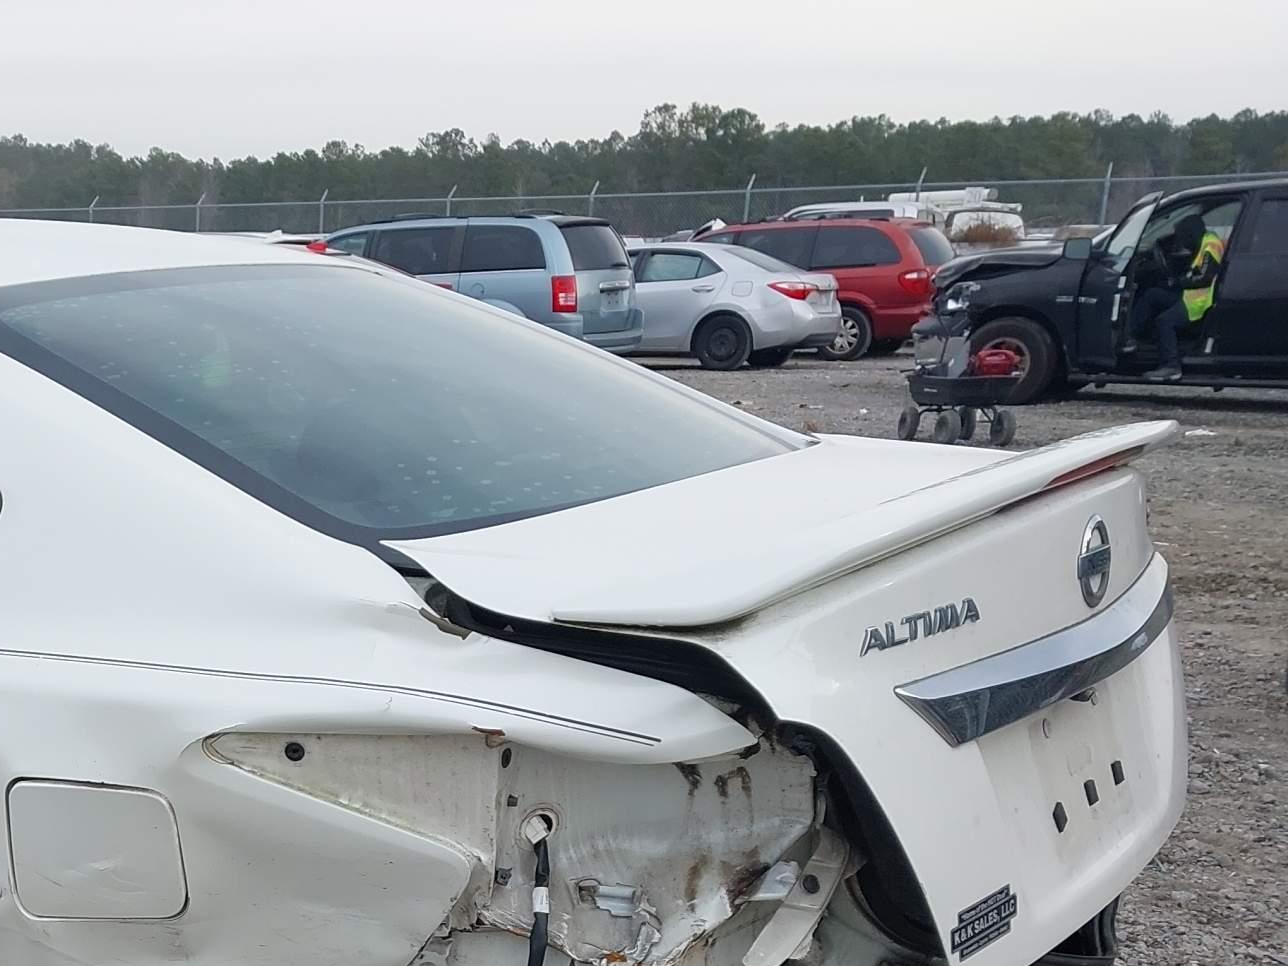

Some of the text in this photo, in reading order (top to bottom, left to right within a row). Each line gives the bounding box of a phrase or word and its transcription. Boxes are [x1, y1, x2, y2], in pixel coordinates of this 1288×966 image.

[860, 597, 981, 657] ALTIMA
[954, 930, 961, 946] K
[968, 922, 974, 938] K
[974, 909, 1000, 934] SALES,
[1002, 899, 1014, 917] LLC
